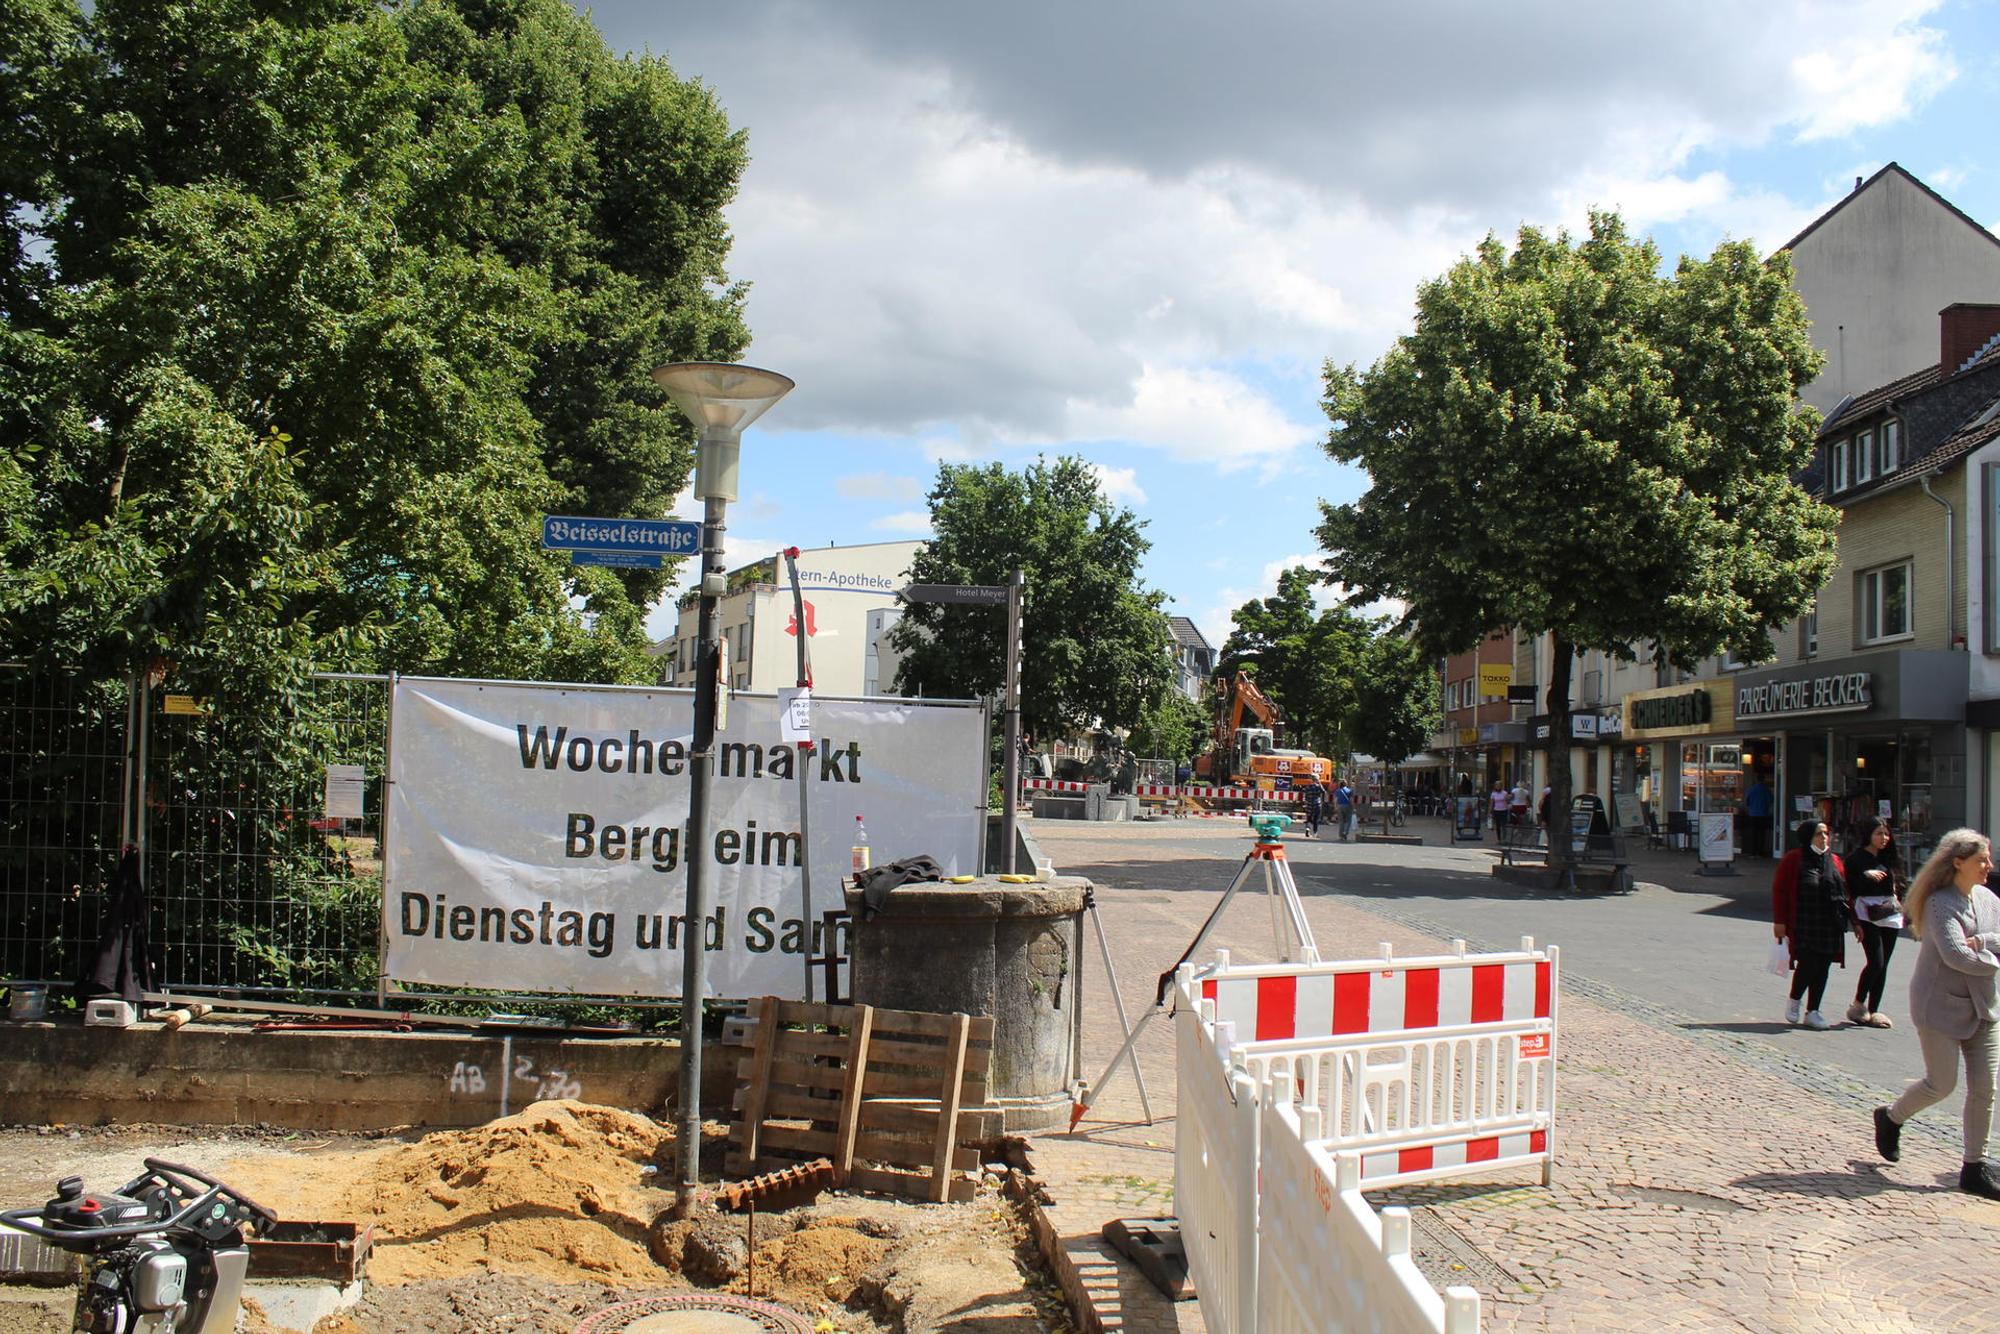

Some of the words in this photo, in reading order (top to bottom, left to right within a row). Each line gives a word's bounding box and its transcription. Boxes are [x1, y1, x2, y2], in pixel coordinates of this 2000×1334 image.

[550, 521, 692, 550] Beisselstraße
[955, 588, 979, 597] Hotel
[981, 589, 1006, 599] Meyer
[1739, 679, 1810, 714] PARFÜMERIE
[1813, 672, 1866, 706] BECKER
[565, 813, 803, 873] Bergeim
[401, 891, 616, 959] Dienstag
